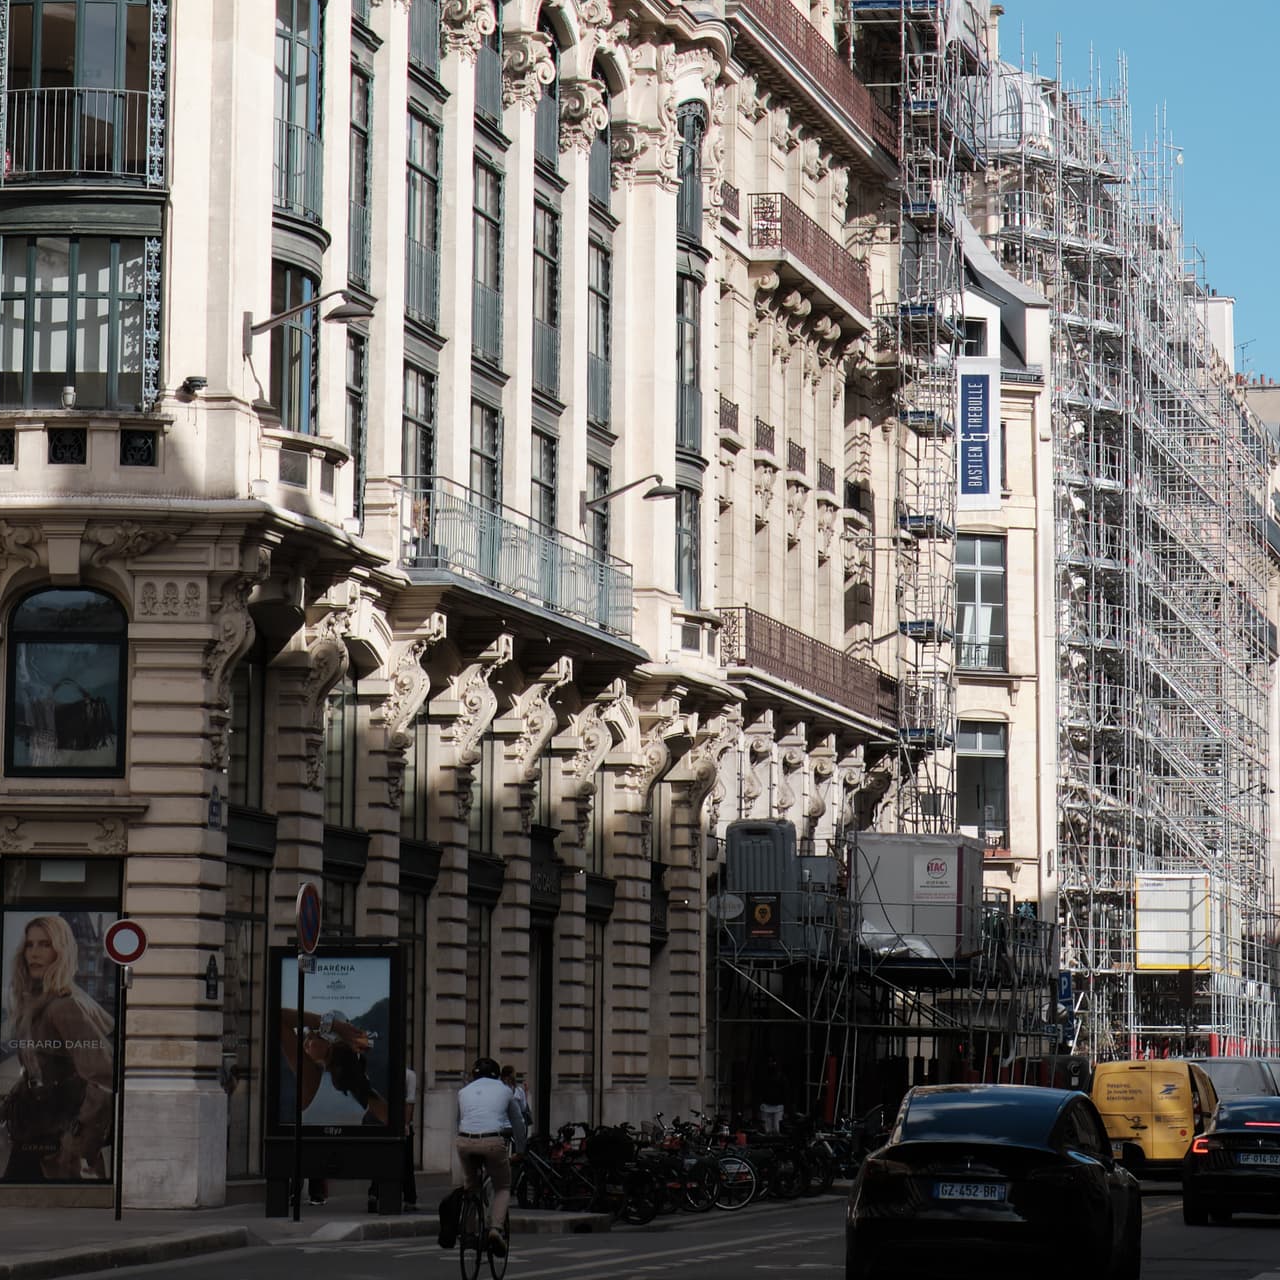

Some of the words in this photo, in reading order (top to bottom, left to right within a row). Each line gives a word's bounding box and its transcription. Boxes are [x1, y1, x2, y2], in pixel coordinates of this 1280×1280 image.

[968, 383, 983, 427] TREBULLE
[968, 447, 983, 486] BASTIEN
[8, 1039, 63, 1049] GERARD
[65, 1039, 106, 1049] DAREL
[941, 1184, 998, 1198] GZ-452-BR
